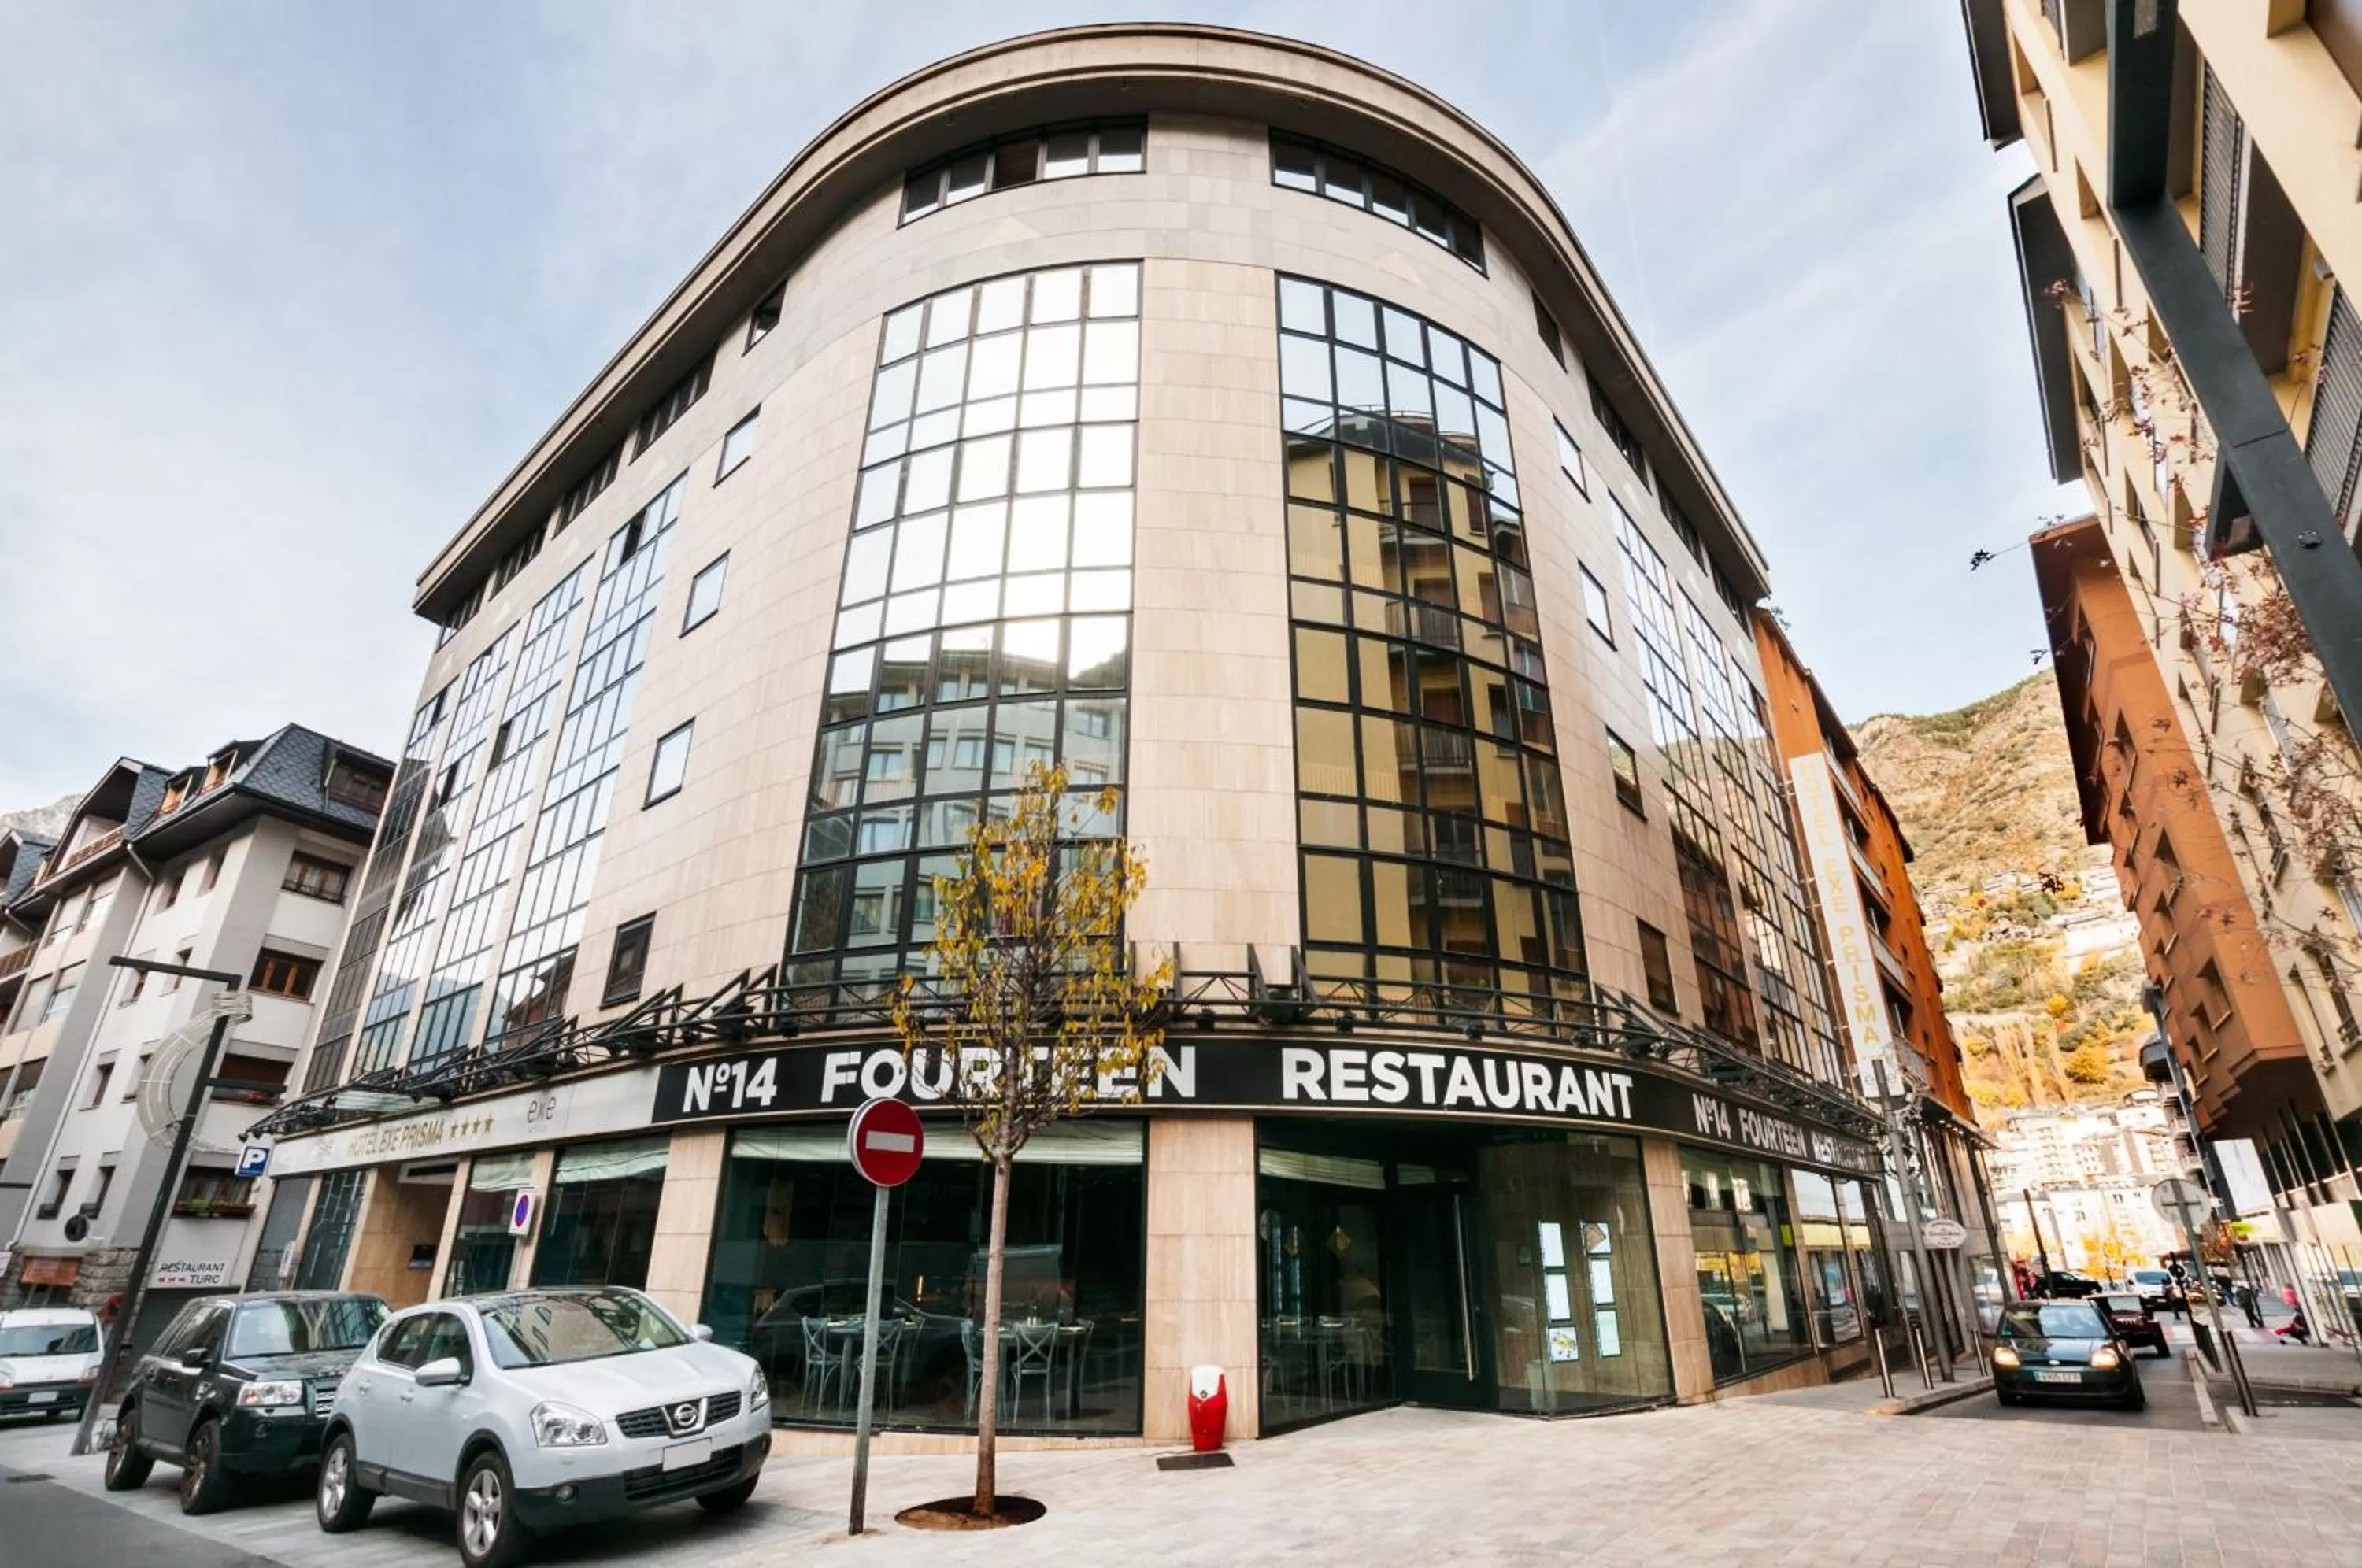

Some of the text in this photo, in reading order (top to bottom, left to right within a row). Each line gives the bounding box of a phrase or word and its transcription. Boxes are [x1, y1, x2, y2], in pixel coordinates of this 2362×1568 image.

[1838, 925, 1880, 1044] PRISMA
[1281, 1048, 1633, 1119] RESTAURANT
[399, 1119, 445, 1150] PRISMA
[1738, 1108, 1808, 1157] FOURTEEN
[242, 1148, 266, 1168] P
[159, 1262, 225, 1273] RESTAURANT
[190, 1274, 221, 1285] TURC
